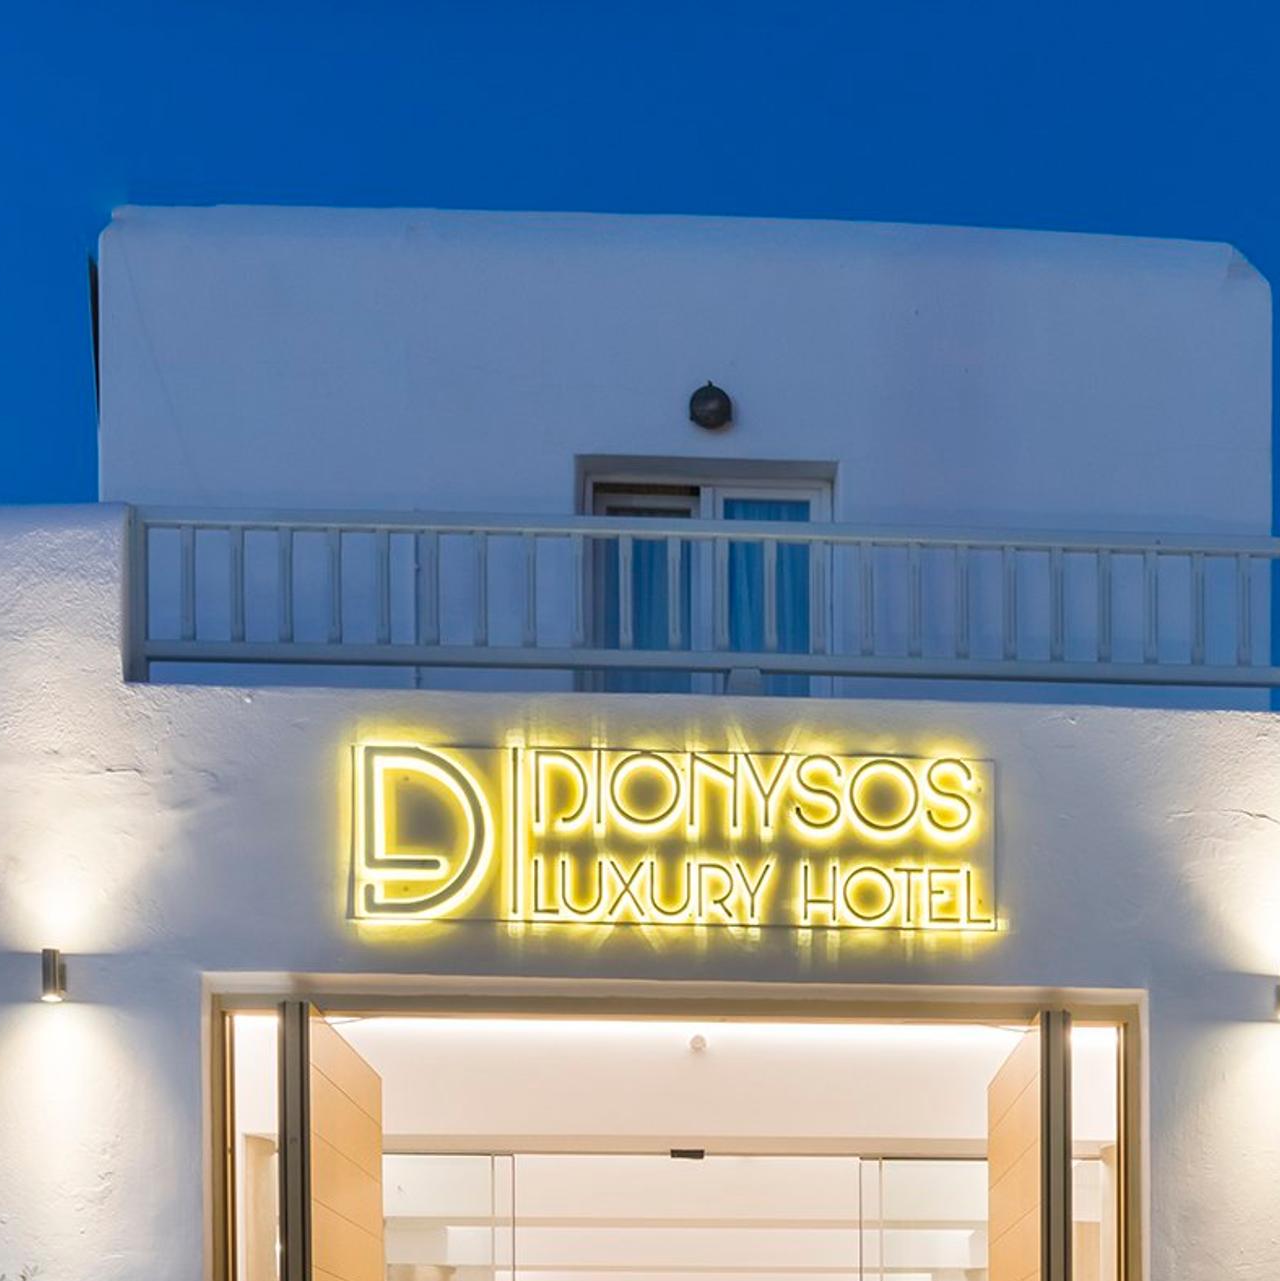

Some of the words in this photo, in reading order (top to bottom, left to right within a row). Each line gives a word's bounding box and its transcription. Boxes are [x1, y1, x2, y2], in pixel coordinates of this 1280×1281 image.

[533, 748, 972, 832] DIONYSOS
[533, 859, 772, 918] LUXURY
[803, 864, 992, 923] HOTEL
